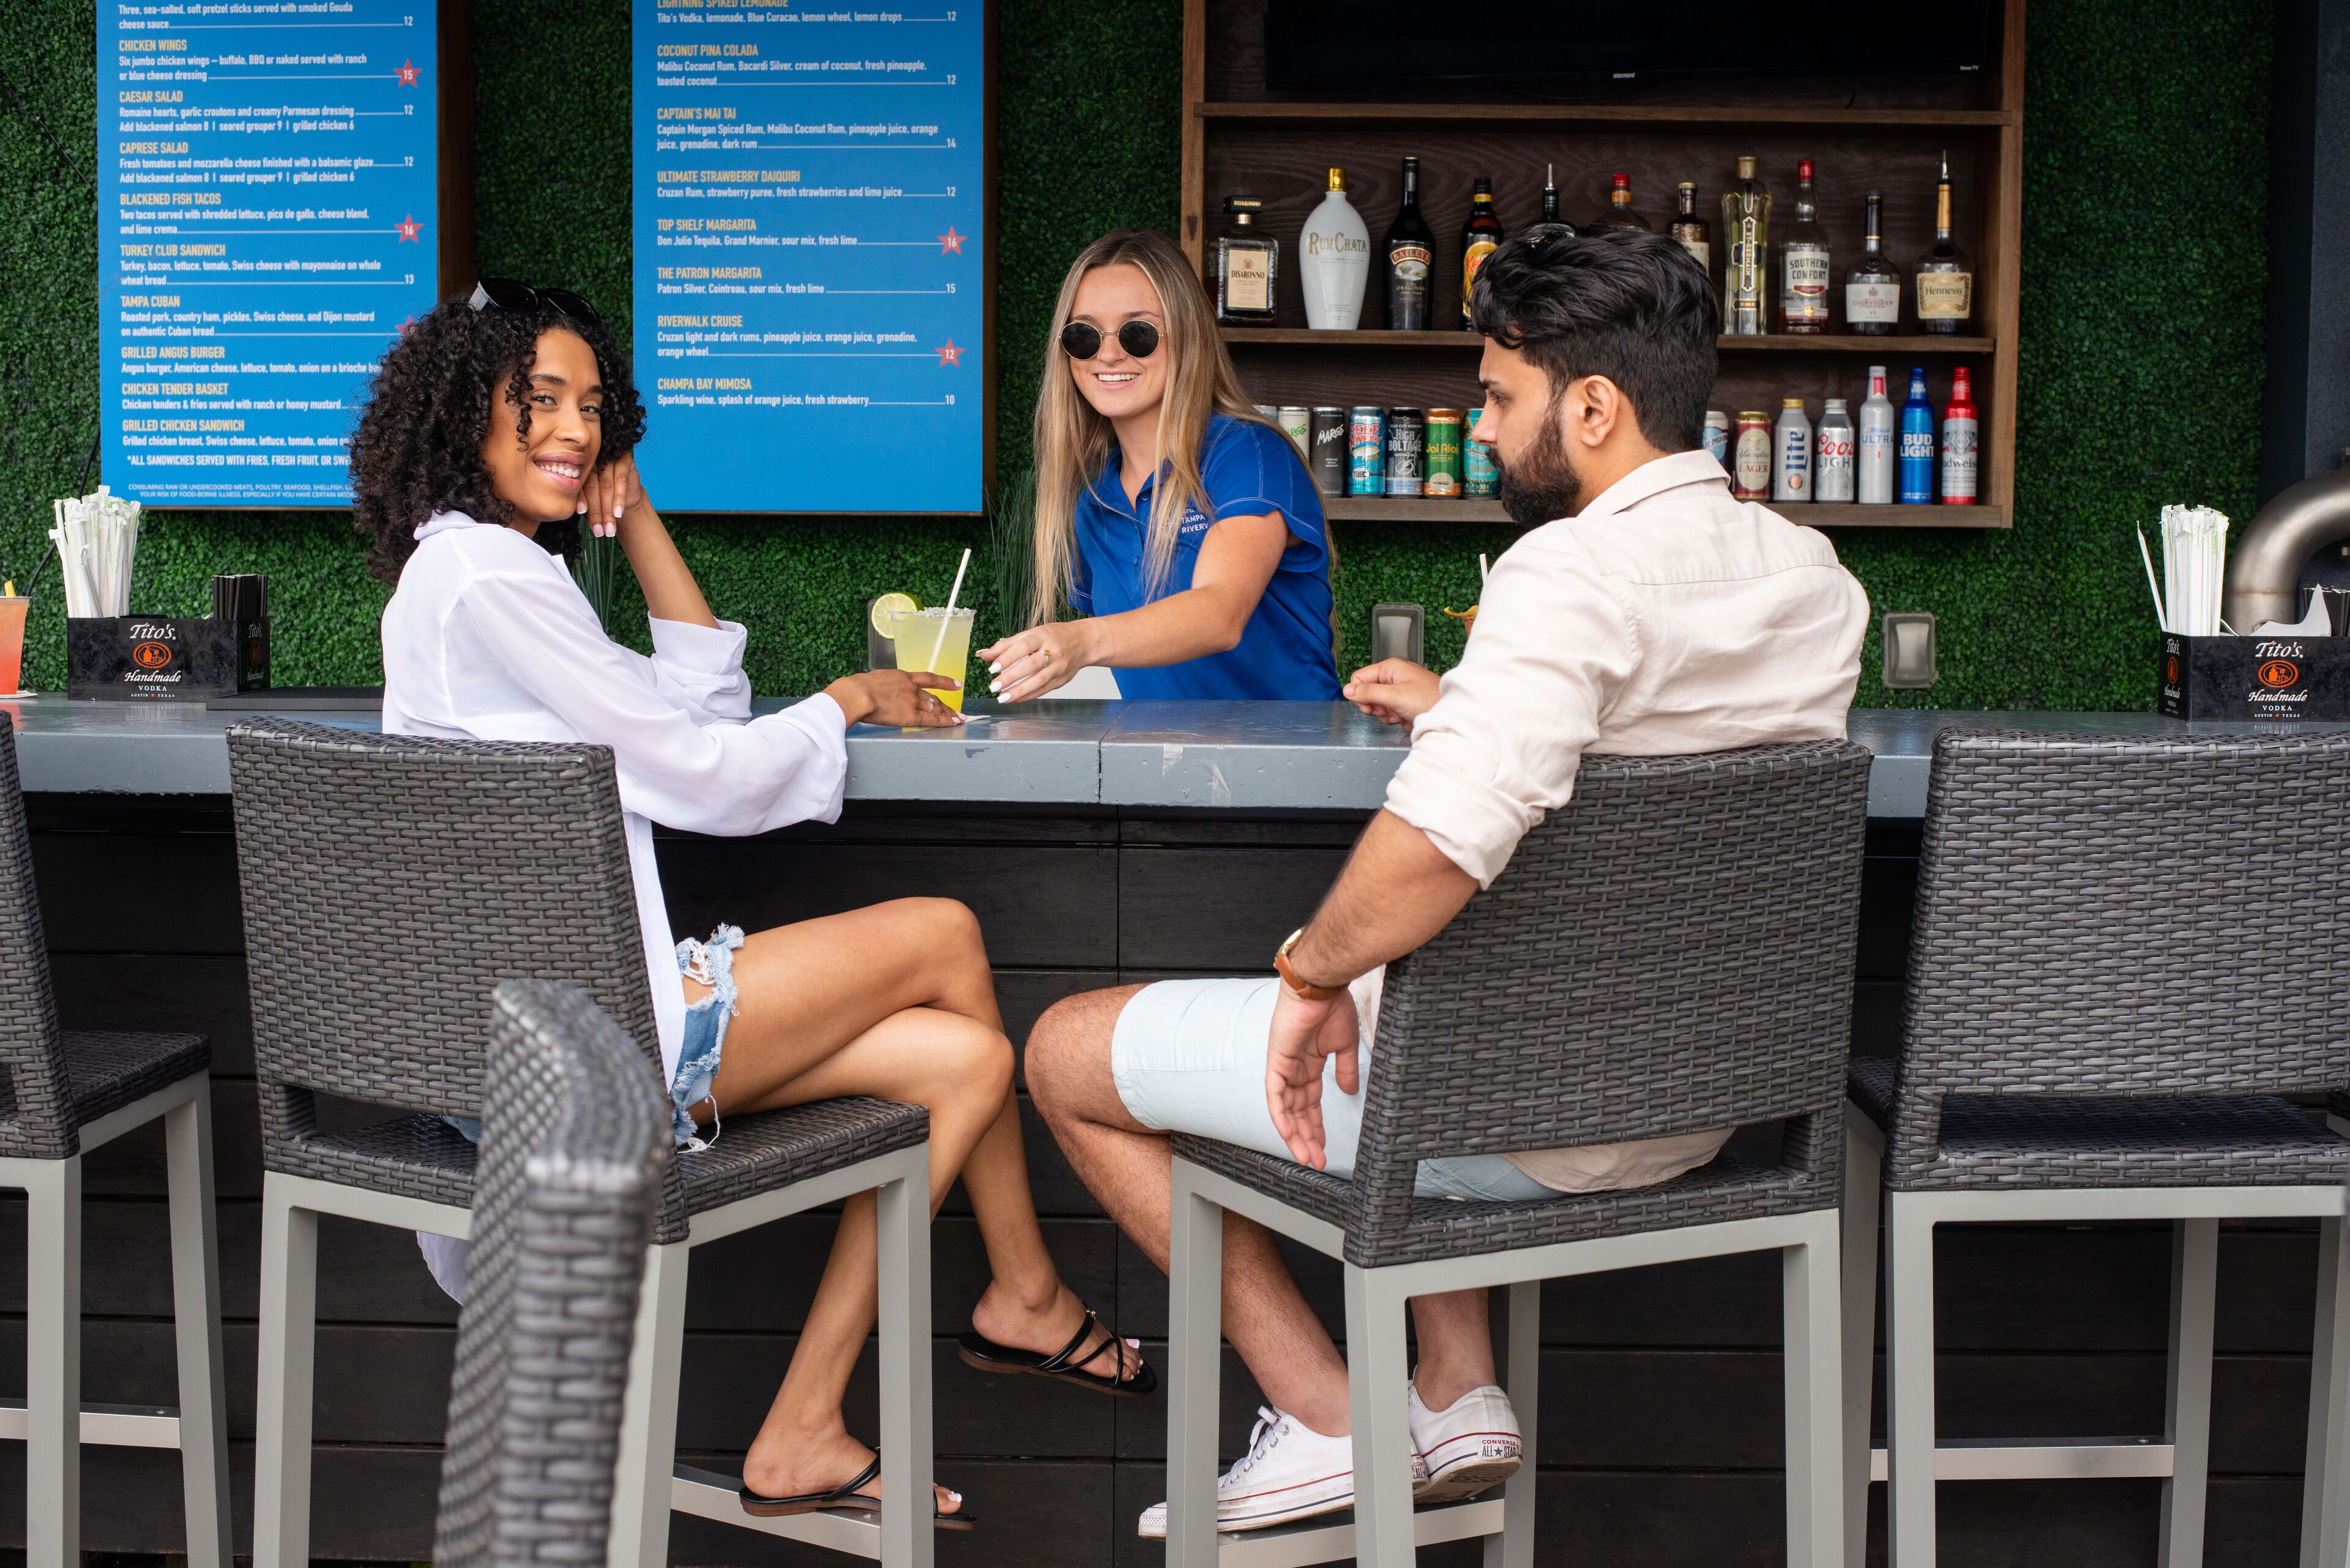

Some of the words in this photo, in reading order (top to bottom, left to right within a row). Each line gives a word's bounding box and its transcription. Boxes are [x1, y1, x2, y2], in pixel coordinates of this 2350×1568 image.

[403, 16, 413, 26] 12
[946, 12, 957, 21] 12
[119, 40, 156, 51] CHICKEN
[158, 40, 187, 51] WINGS
[657, 45, 698, 56] COCONUT
[700, 45, 722, 56] PINA
[723, 45, 758, 56] COLADA
[403, 70, 412, 80] 15
[946, 74, 956, 84] 12
[119, 91, 153, 102] CAESAR
[155, 91, 182, 102] SALAD
[403, 105, 413, 114] 12
[657, 108, 702, 119] CAPTAIN'S
[704, 108, 721, 119] MAI
[723, 108, 736, 119] TAI
[120, 142, 159, 154] CAPRESE
[160, 142, 188, 154] SALAD
[945, 138, 956, 147] 14
[403, 157, 414, 166] 12
[657, 171, 698, 182] ULTIMATE
[700, 171, 759, 182] STRAWBERRY
[761, 171, 800, 182] DAIQUIRI
[946, 187, 956, 196] 12
[120, 193, 170, 205] BLACKENED
[172, 193, 192, 204] FISH
[194, 193, 220, 204] TACOS
[405, 225, 414, 235] 16
[657, 219, 674, 230] TOP
[676, 219, 704, 230] SHELF
[706, 219, 756, 230] MARGARITA
[657, 235, 672, 245] Don
[674, 236, 692, 245] Julio
[693, 235, 722, 247] Tequila,
[724, 235, 747, 245] Grand
[749, 236, 780, 245] Marnier,
[801, 236, 816, 245] mix,
[819, 235, 838, 245] fresh
[841, 235, 859, 245] lime
[948, 237, 957, 247] 16
[121, 245, 153, 256] TURKEY
[155, 245, 178, 256] CLUB
[180, 245, 225, 256] SANDWICH
[1393, 249, 1430, 261] BAILEYS
[1790, 259, 1828, 269] SOUTHERN
[657, 267, 673, 278] THE
[676, 267, 709, 278] PATRON
[711, 267, 761, 278] MARGARITA
[1231, 270, 1265, 279] DISARONNO
[1792, 270, 1826, 280] COMFORT
[403, 274, 414, 285] 13
[945, 283, 955, 293] 15
[1925, 286, 1963, 295] Hennessy
[121, 296, 149, 307] TAMPA
[151, 296, 180, 307] CUBAN
[657, 315, 708, 327] RIVERWALK
[711, 316, 742, 327] CRUISE
[122, 346, 157, 358] GRILLED
[159, 346, 188, 358] ANGUS
[190, 346, 225, 358] BURGER
[946, 349, 955, 359] 12
[122, 383, 159, 395] CHICKEN
[161, 383, 194, 395] TENDER
[196, 383, 228, 395] BASKET
[658, 378, 695, 390] CHAMPA
[696, 378, 713, 389] BAY
[715, 378, 752, 389] MIMOSA
[122, 399, 152, 409] Chicken
[153, 400, 182, 409] tenders
[183, 400, 188, 409] &
[190, 399, 208, 409] fries
[209, 400, 234, 409] served
[236, 399, 252, 409] with
[253, 399, 275, 409] ranch
[286, 400, 309, 411] honey
[310, 400, 342, 409] mustard
[944, 395, 955, 405] 10
[122, 419, 158, 431] GRILLED
[160, 420, 197, 431] CHICKEN
[199, 420, 244, 431] SANDWICH
[1903, 433, 1933, 446] BUD
[1389, 440, 1422, 452] BOLTAGE
[1786, 431, 1808, 472] Lite
[1900, 446, 1934, 458] LIGHT
[1739, 465, 1769, 473] LAGER
[1181, 514, 1206, 524] TAMPA
[130, 622, 175, 640] Tito's
[2166, 638, 2180, 655] Tito's
[2255, 640, 2302, 659] Tito's
[124, 669, 182, 683] Handmade
[2248, 689, 2308, 702] Handmade
[1482, 1446, 1494, 1457] ALL
[1504, 1446, 1518, 1458] STAR
